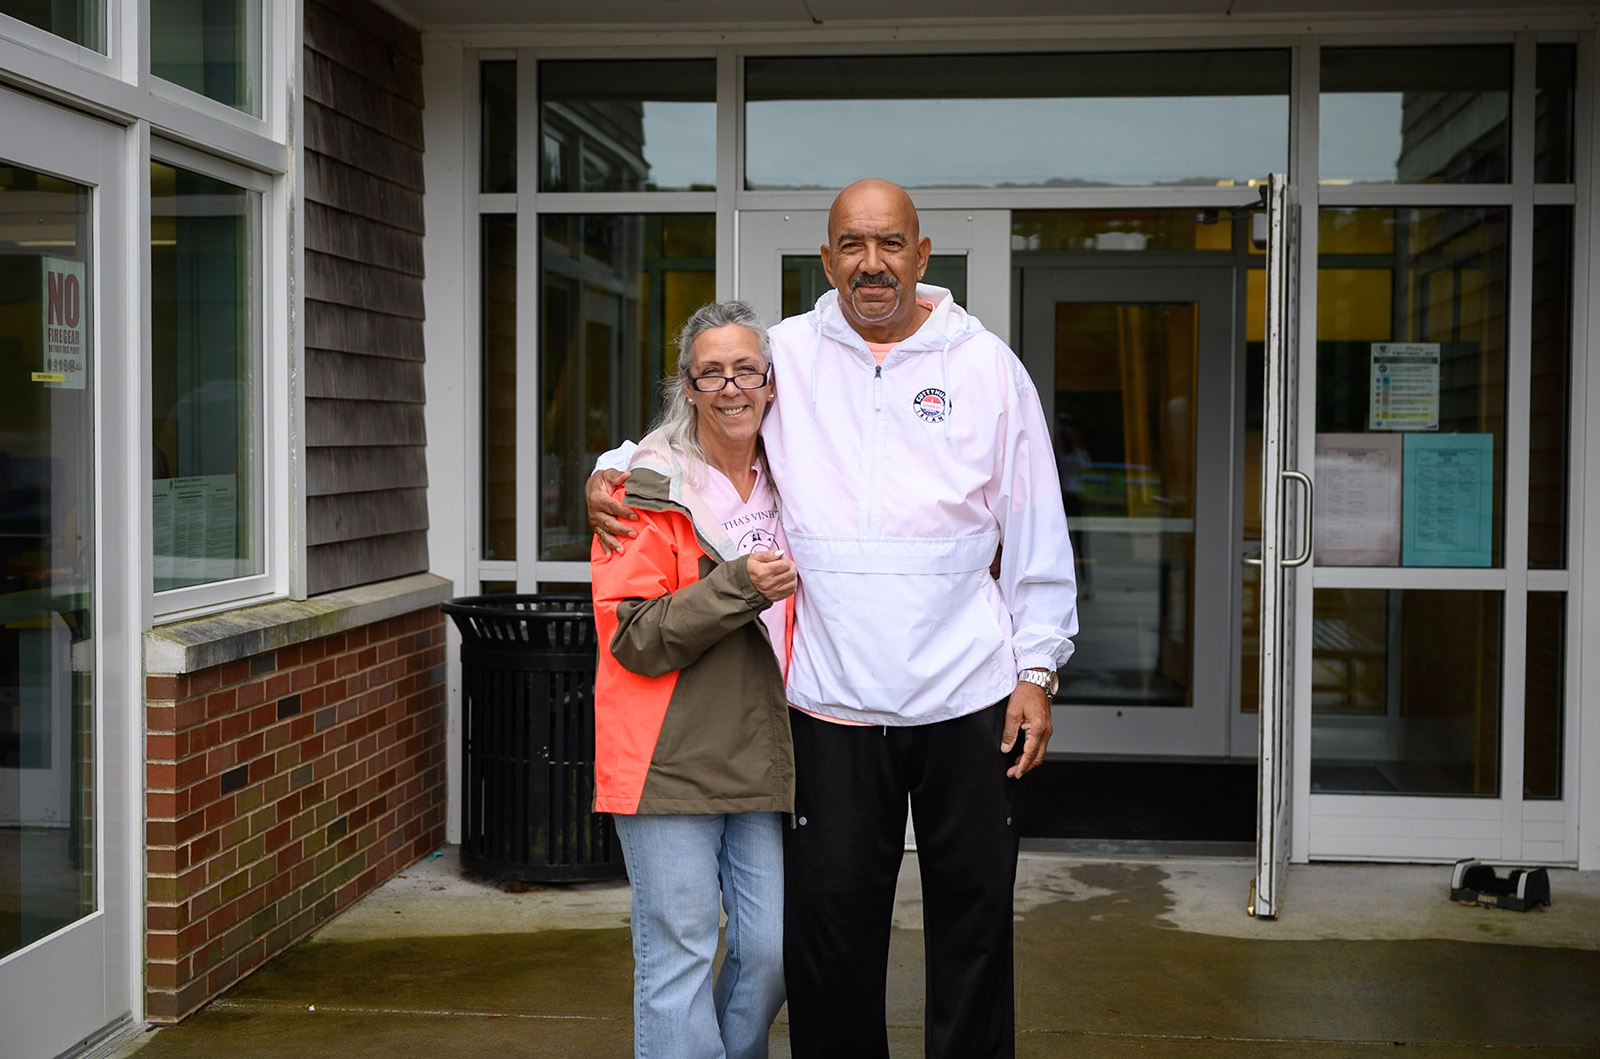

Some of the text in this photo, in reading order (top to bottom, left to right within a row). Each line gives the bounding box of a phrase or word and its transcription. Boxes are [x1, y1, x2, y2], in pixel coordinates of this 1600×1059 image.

[48, 271, 80, 328] NO
[916, 389, 946, 402] CUTTYHU
[916, 409, 945, 422] ISLAN
[722, 515, 751, 531] THA'S
